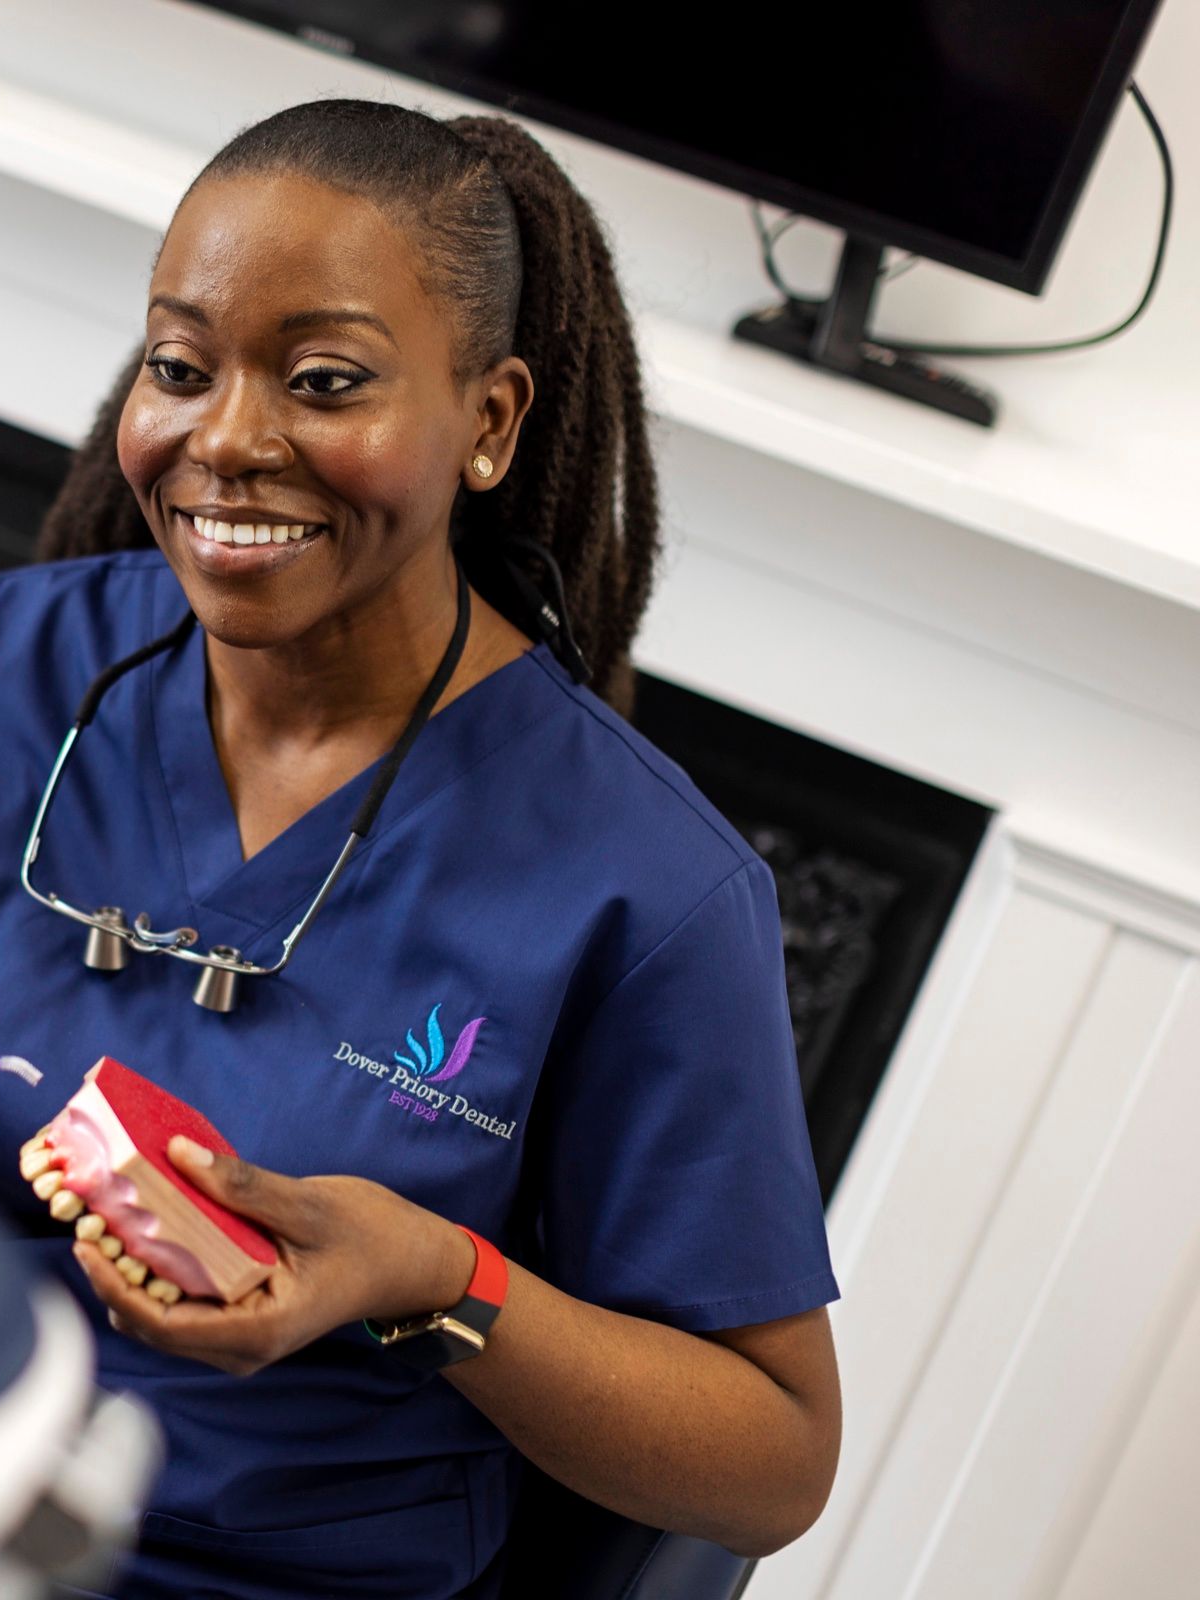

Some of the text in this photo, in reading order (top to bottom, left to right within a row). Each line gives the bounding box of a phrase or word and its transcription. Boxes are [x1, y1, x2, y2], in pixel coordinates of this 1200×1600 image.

[333, 1042, 516, 1140] Dover Priory Dental
[388, 1090, 439, 1122] EST 1928
